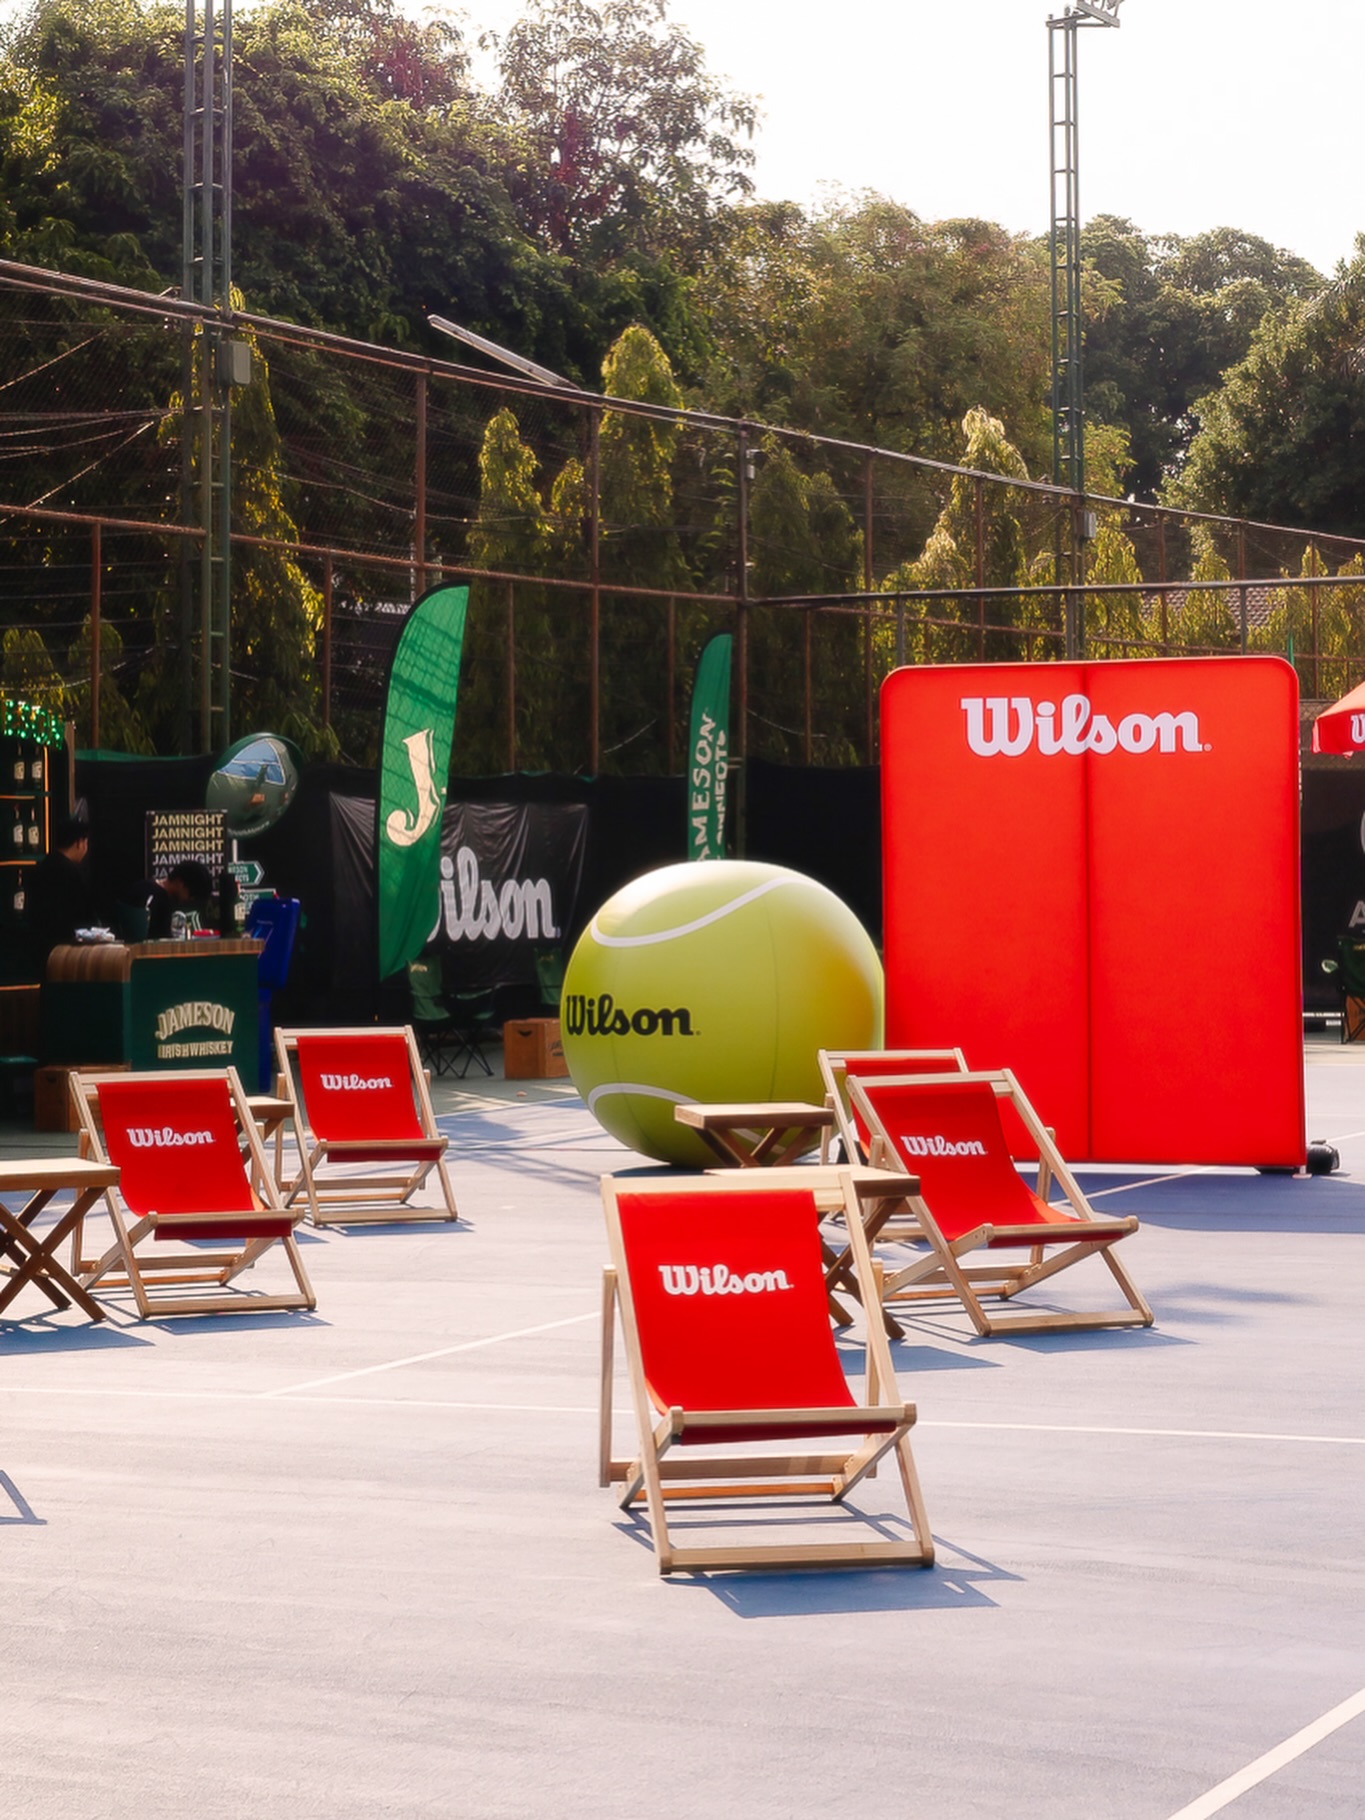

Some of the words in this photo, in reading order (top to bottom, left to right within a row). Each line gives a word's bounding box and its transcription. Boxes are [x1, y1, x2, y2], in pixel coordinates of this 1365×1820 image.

[961, 694, 1204, 758] Wilson
[152, 814, 224, 826] JAMNIGHT
[152, 827, 224, 839] JAMNIGHT
[152, 840, 224, 852] JAMNIGHT
[427, 846, 556, 941] ilson
[155, 1001, 235, 1040] JAMESON
[566, 993, 694, 1036] Wilson
[158, 1043, 189, 1059] IRISH
[189, 1041, 233, 1056] WHISKEY
[320, 1073, 392, 1091] Wilson
[127, 1126, 214, 1148] Wilson
[900, 1134, 987, 1157] Wilson
[658, 1263, 790, 1296] Wilson
